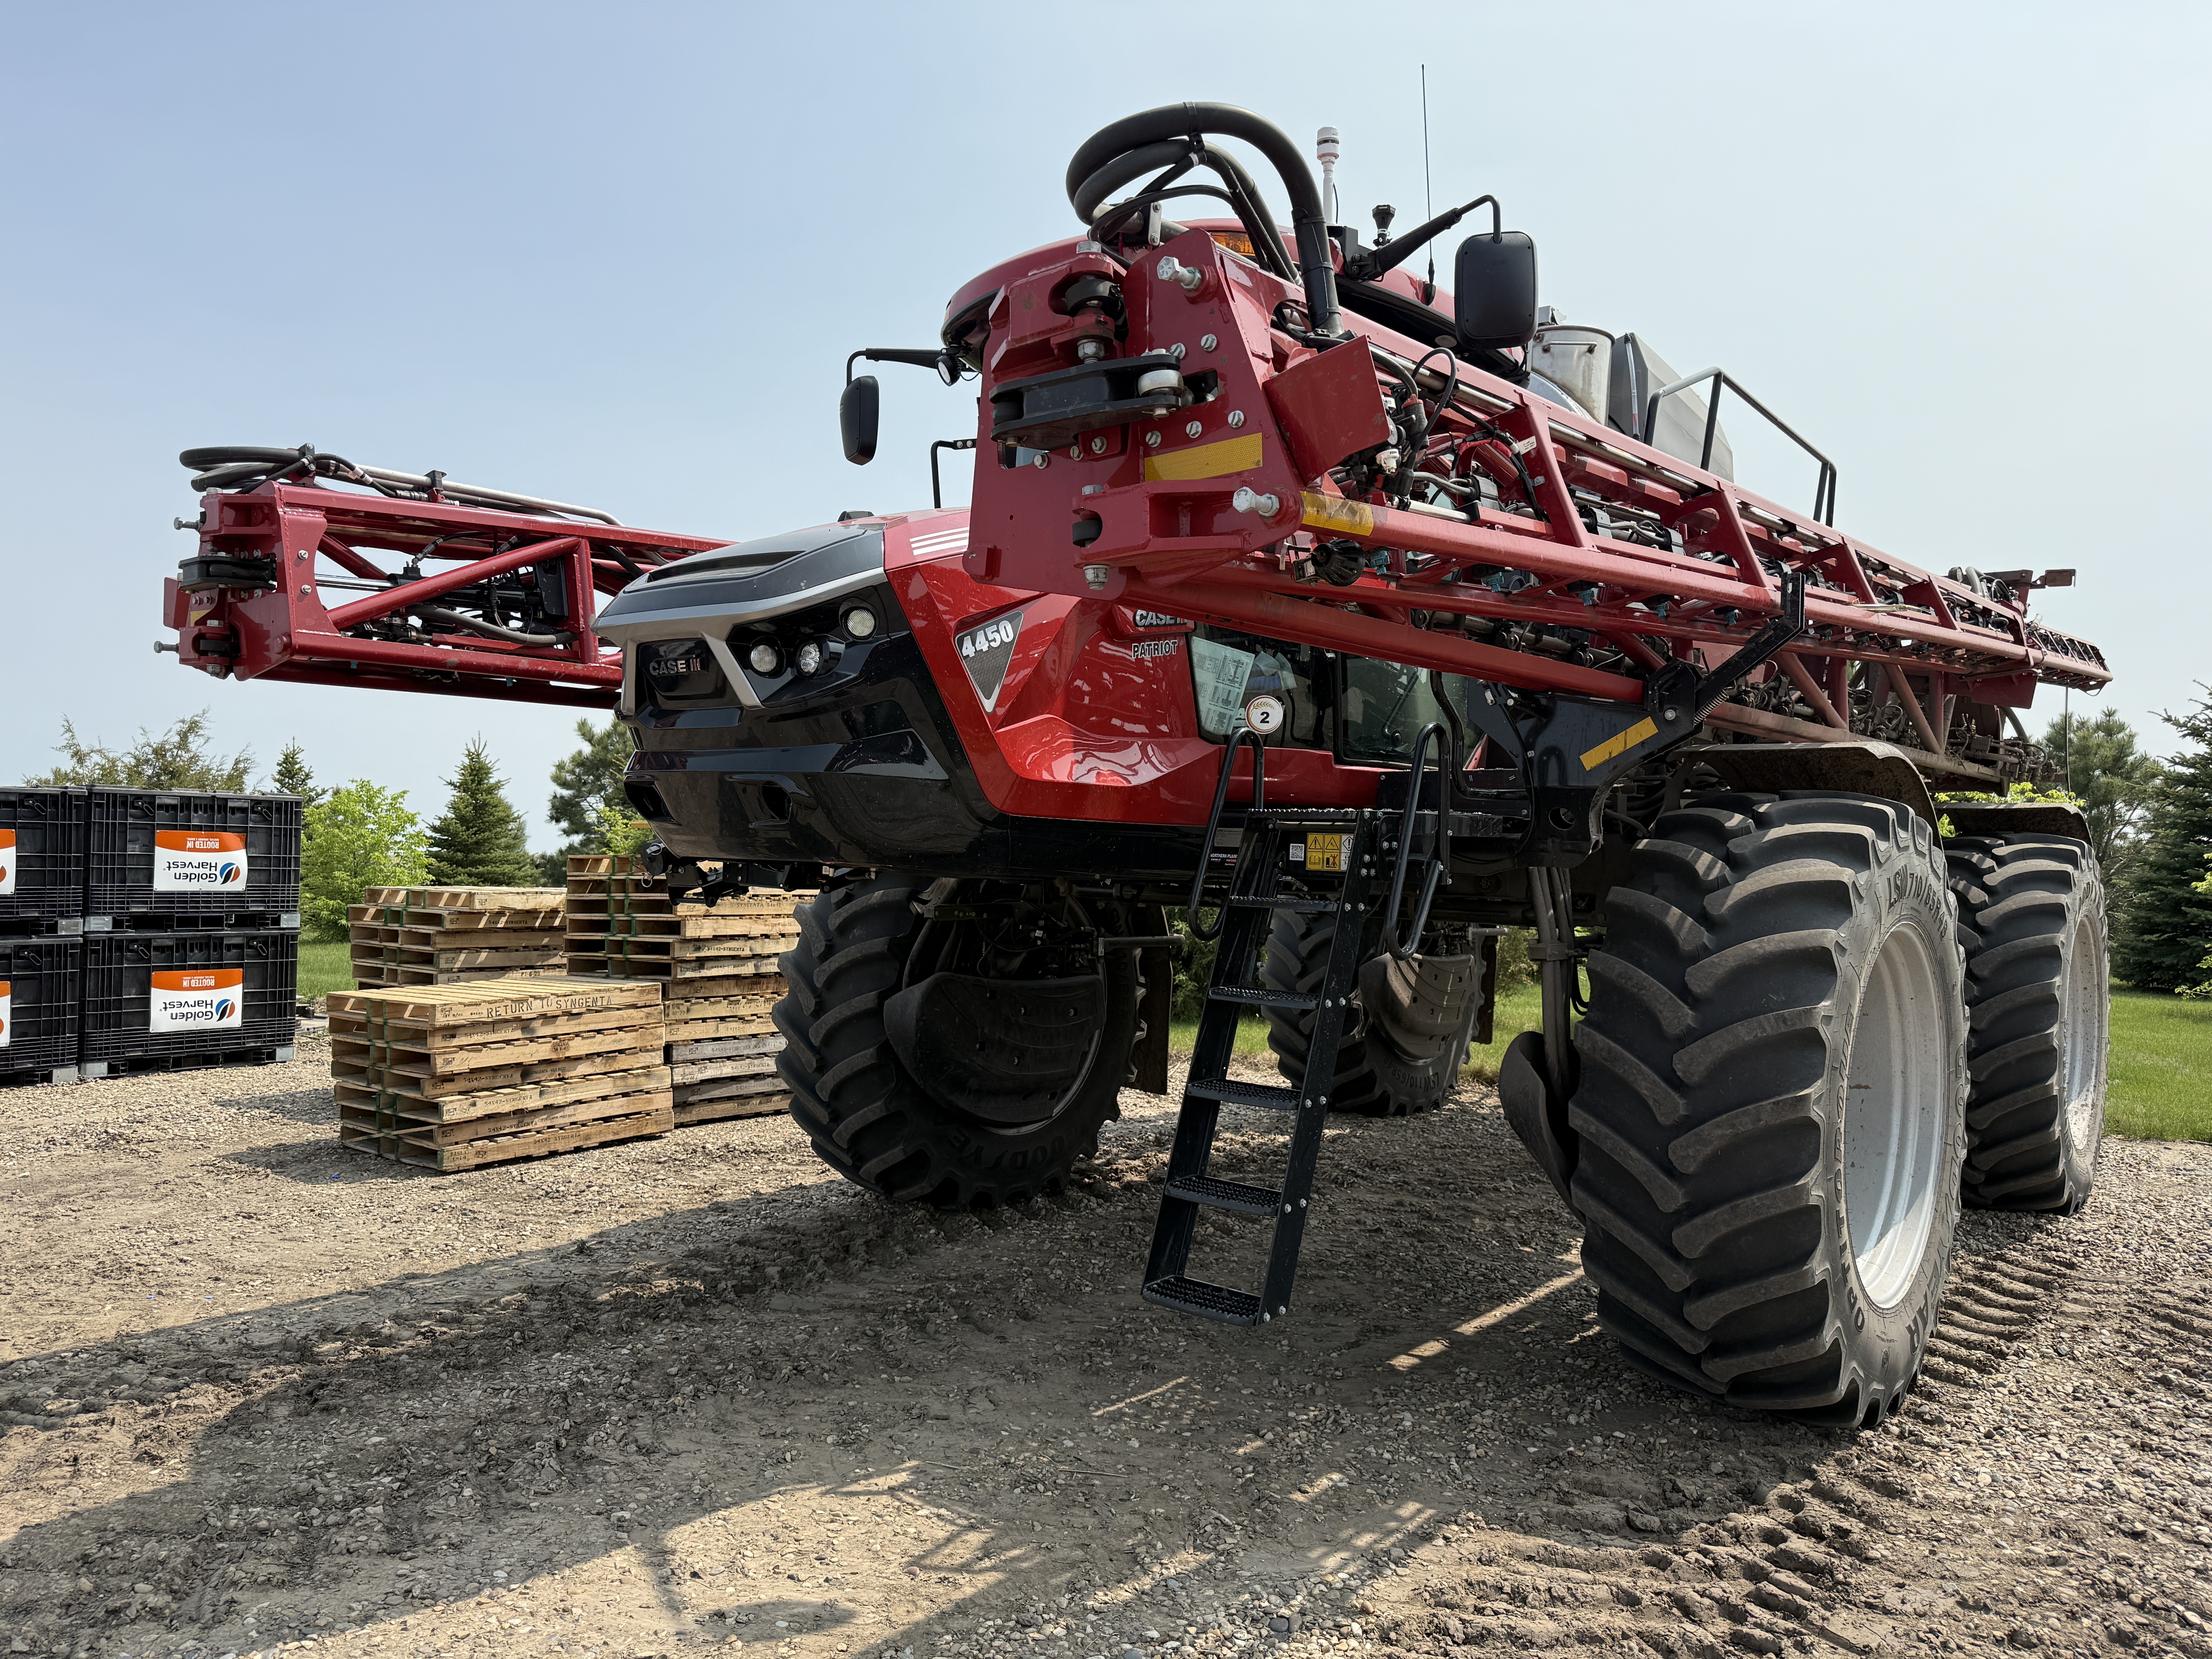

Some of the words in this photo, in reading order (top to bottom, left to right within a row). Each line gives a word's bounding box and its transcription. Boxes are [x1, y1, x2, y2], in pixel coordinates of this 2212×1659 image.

[962, 620, 1014, 658] 4450
[1132, 640, 1178, 659] PATRIOT
[649, 660, 686, 675] CASE
[1260, 711, 1270, 724] 2
[187, 840, 194, 848] IN
[167, 861, 218, 871] Harvest
[174, 872, 218, 883] Golden
[183, 979, 189, 988] IN
[191, 979, 215, 987] ROOTED
[163, 1000, 213, 1012] Harvest
[487, 1001, 533, 1018] RETURN
[556, 996, 611, 1009] SYNGENTA
[170, 1011, 213, 1021] Golden
